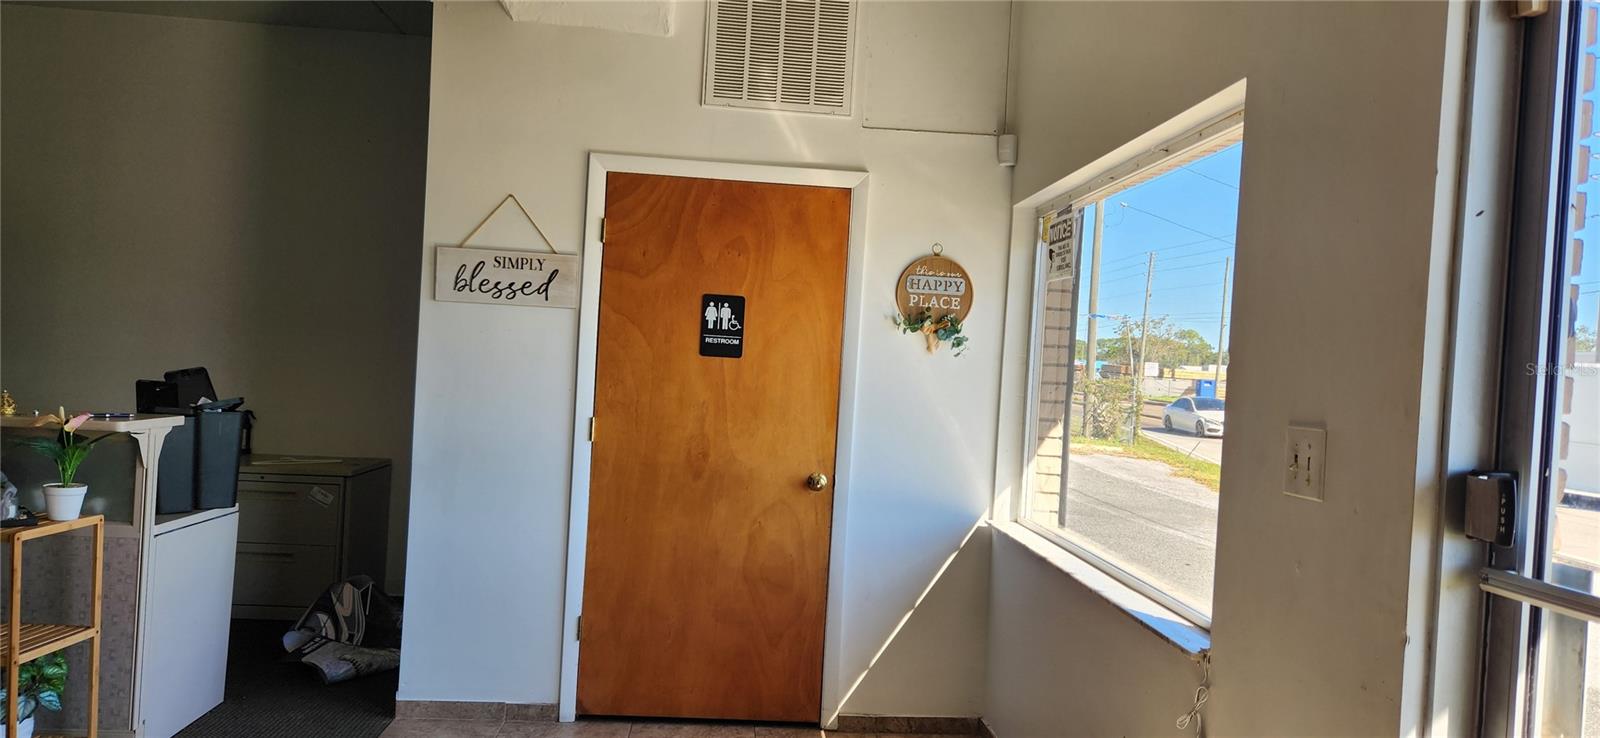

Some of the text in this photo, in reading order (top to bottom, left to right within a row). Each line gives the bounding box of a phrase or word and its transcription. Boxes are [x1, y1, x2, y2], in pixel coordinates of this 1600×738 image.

[493, 256, 546, 271] SIMPLY
[916, 265, 935, 276] this
[936, 268, 945, 277] is
[453, 261, 559, 301] blessed
[909, 278, 963, 292] HAPPY
[909, 295, 961, 309] PLACE
[705, 337, 740, 345] RESTROOM
